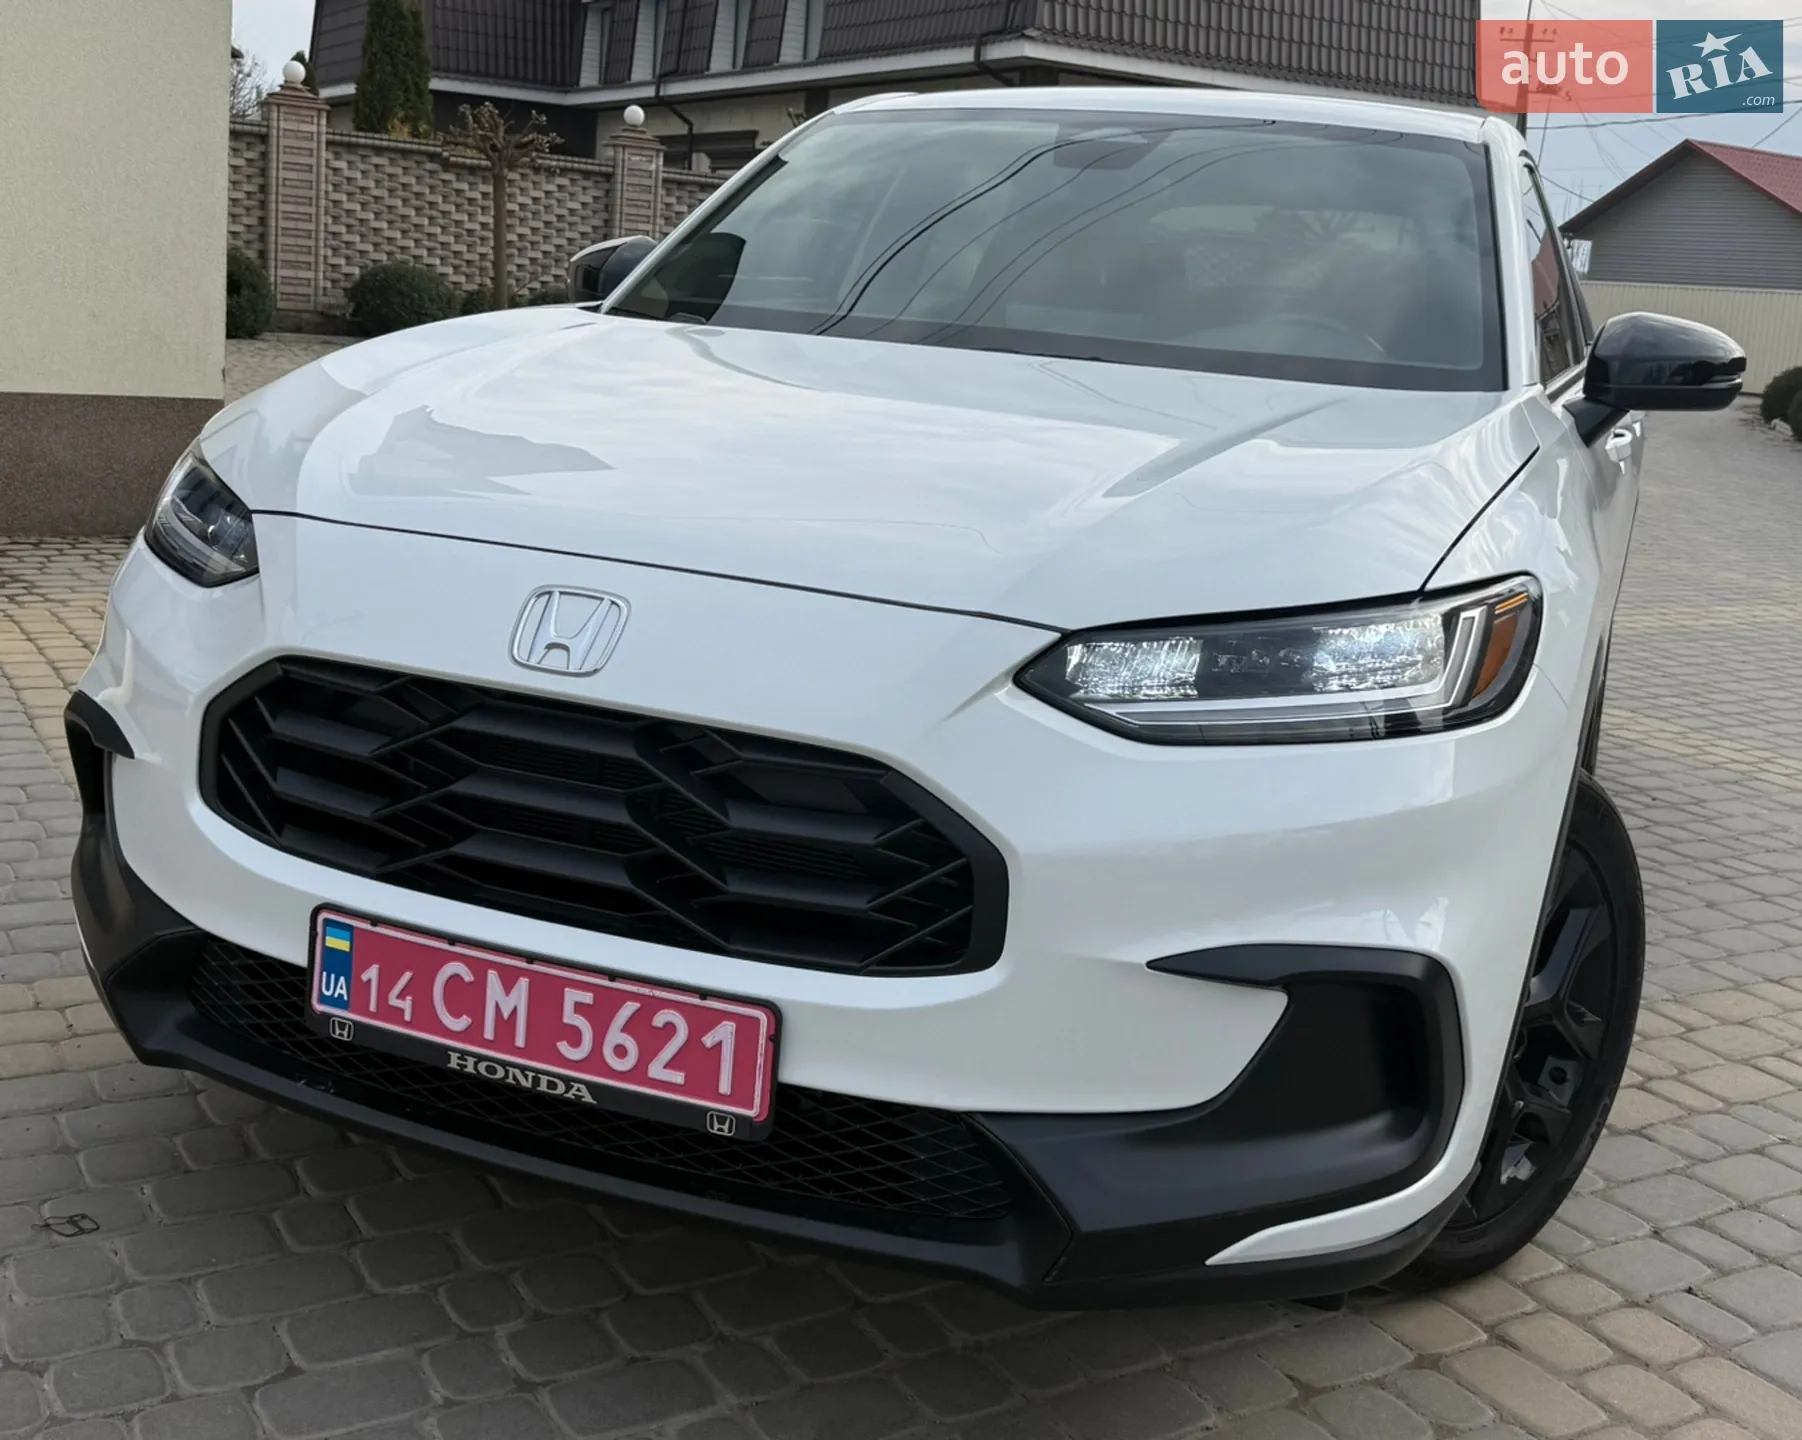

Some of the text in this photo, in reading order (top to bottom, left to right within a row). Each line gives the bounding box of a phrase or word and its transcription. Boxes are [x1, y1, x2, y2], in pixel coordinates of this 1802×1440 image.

[321, 970, 349, 1001] UA
[360, 961, 736, 1096] 14 CM 5621
[446, 1051, 598, 1105] HONDA
